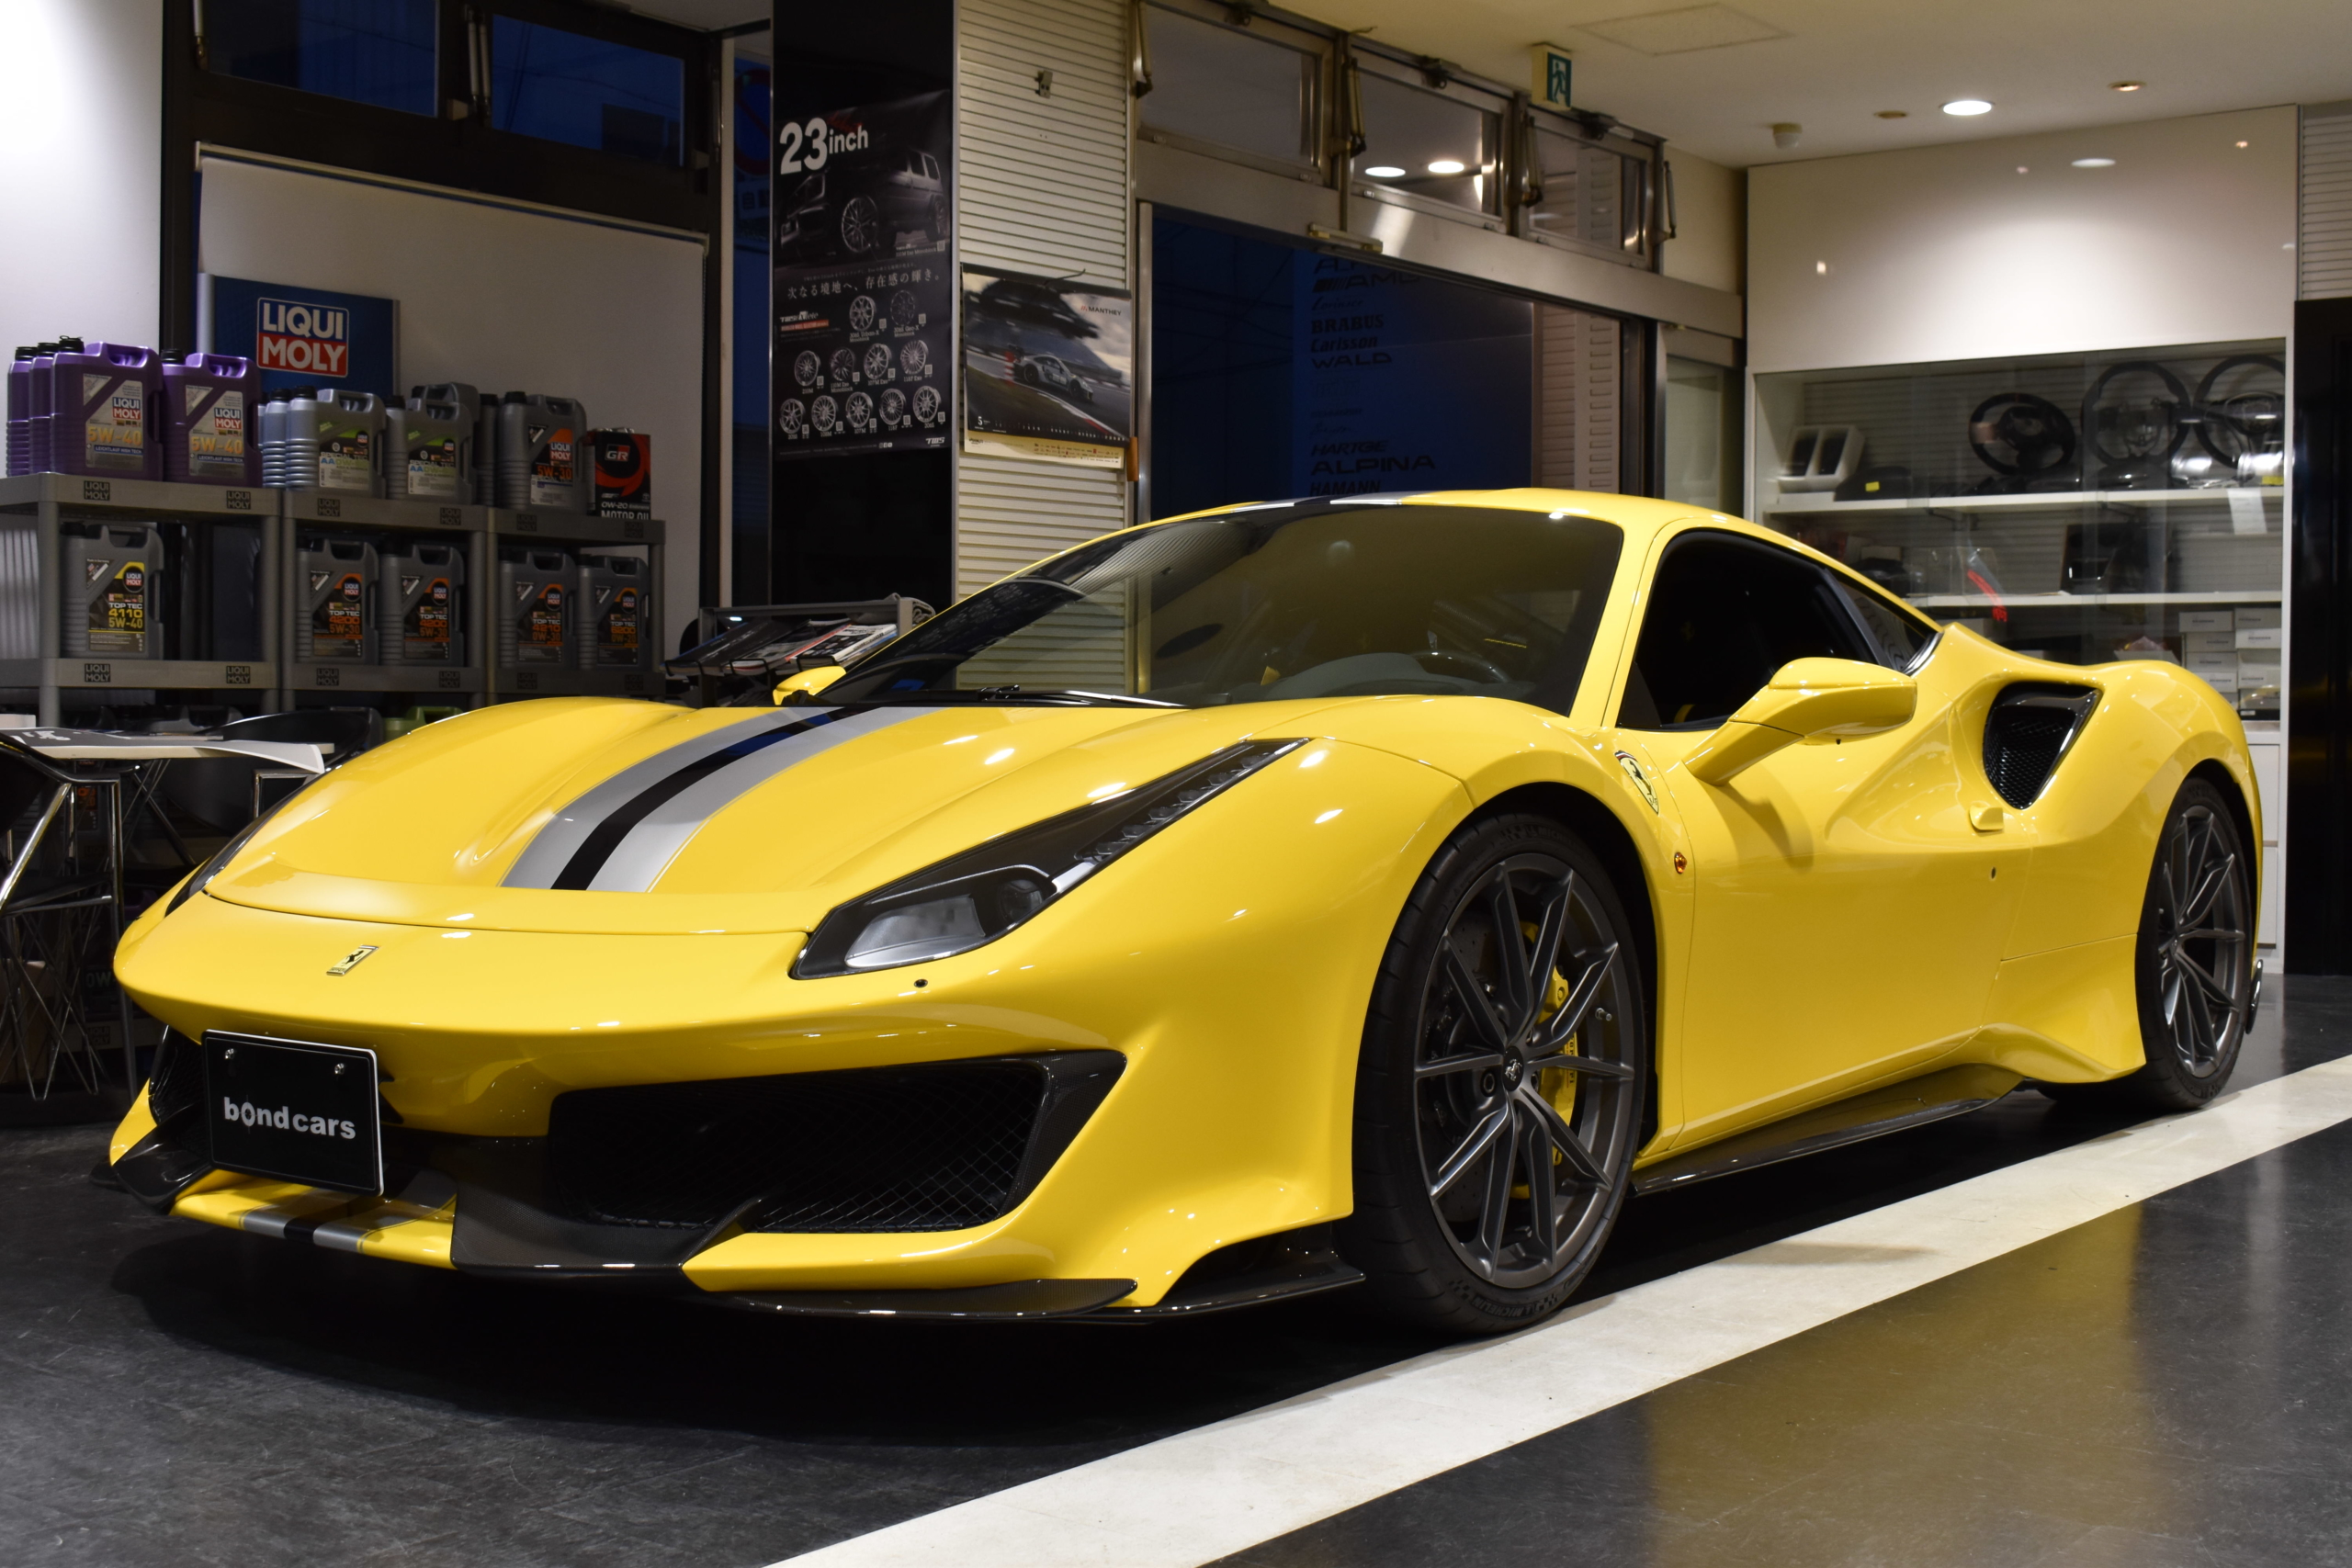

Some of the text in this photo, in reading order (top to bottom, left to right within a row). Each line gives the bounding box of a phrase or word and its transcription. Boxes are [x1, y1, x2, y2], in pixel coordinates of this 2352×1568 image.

[1088, 306, 1121, 316] MANTHEY
[264, 303, 344, 339] LIQUI
[1311, 314, 1385, 334] BRABUS
[1311, 336, 1378, 353] Carlsson
[263, 337, 346, 372] MOLY
[1311, 352, 1392, 368] WALD
[114, 399, 140, 410] LIQUI
[114, 409, 140, 419] MOLY
[216, 408, 241, 418] LIQUI
[216, 418, 241, 429] MOLY
[978, 416, 983, 426] 5
[88, 426, 142, 446] 5W-40
[191, 436, 243, 454] 5W-40
[551, 443, 571, 451] LIQUI
[1311, 440, 1390, 457] HARTGE
[551, 451, 571, 460] MOLY
[606, 451, 629, 461] GR
[1311, 455, 1436, 476] ALPINA
[538, 465, 572, 479] 5W-30
[85, 481, 109, 491] LIQUI
[1310, 479, 1381, 497] HAMANN
[85, 491, 110, 500] MOLY
[228, 491, 250, 500] LIQUI
[228, 500, 250, 509] MOLY
[319, 499, 339, 507] LIQUI
[318, 508, 340, 516] MOLY
[441, 517, 461, 525] MOLY
[108, 609, 143, 618] 4110
[108, 618, 143, 629] 5W-40
[329, 624, 360, 634] 5W-30
[420, 627, 447, 637] 5W-30
[85, 664, 109, 673] LIQUI
[85, 673, 110, 682] MOLY
[227, 675, 250, 683] MOLY
[317, 677, 339, 685] MOLY
[1472, 1296, 1523, 1318] MICHELIN
